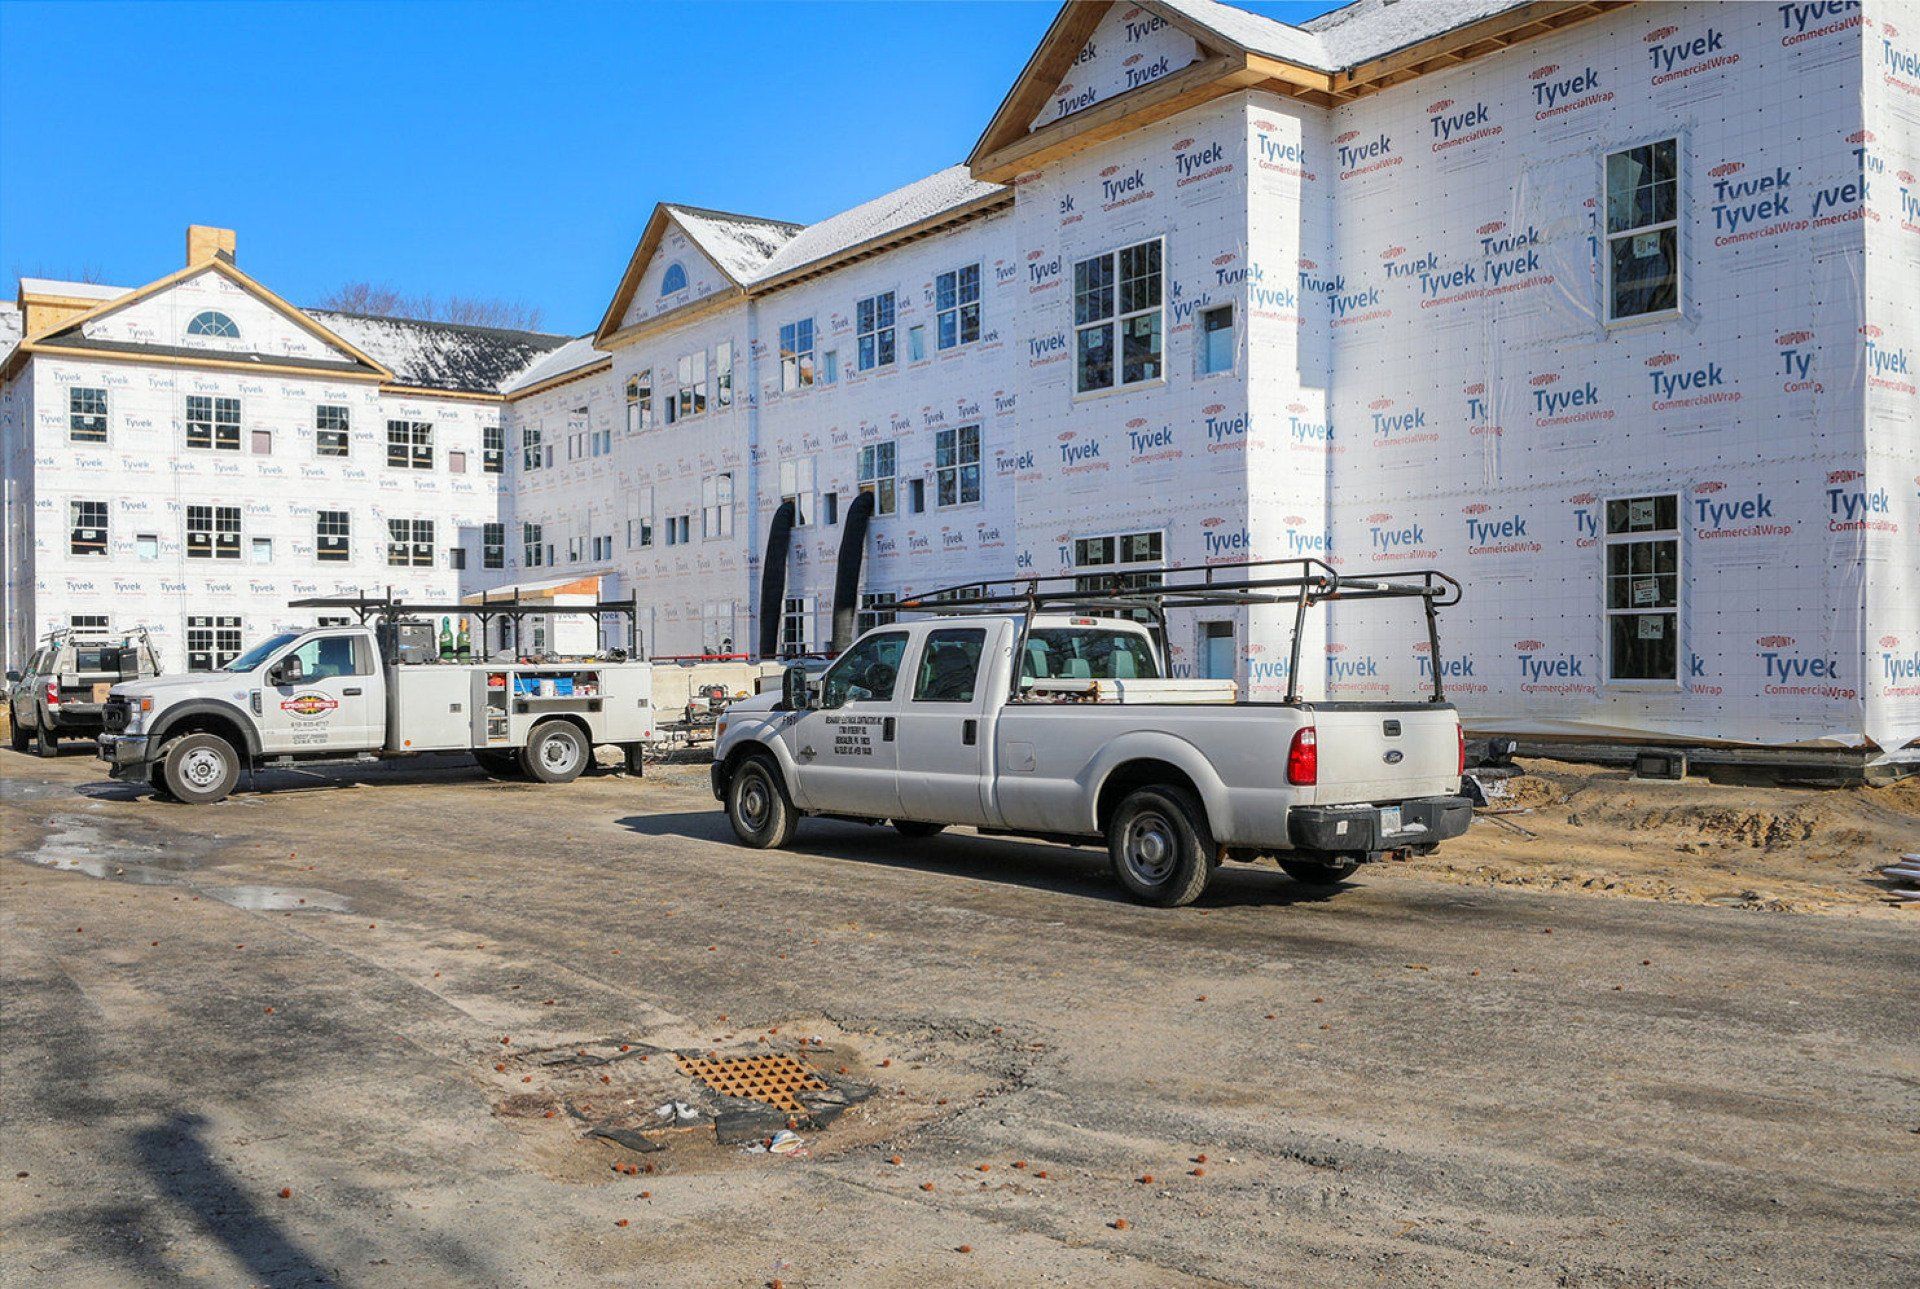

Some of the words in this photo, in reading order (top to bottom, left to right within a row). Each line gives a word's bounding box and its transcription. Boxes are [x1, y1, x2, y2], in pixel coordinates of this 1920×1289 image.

[1648, 28, 1723, 72] Tyvek
[1125, 56, 1168, 87] Tyvek
[1650, 53, 1740, 86] CommercialWrap
[1533, 67, 1599, 108] Tyvek
[1057, 86, 1097, 116] Tyvek
[1535, 90, 1615, 122] CommercialWrap
[1431, 102, 1488, 140] Tyvek
[1257, 134, 1306, 164] Tyvek
[1338, 134, 1391, 168] Tyvek
[1432, 124, 1503, 153] CommercialWrap
[1175, 142, 1223, 176] Tyvek
[1340, 156, 1403, 181] CommercialWrap
[1102, 169, 1145, 201] Tyvek
[1711, 192, 1789, 233] Tyvek
[1714, 219, 1809, 247] CommercialWrap
[1419, 265, 1475, 299] Tyvek
[1246, 282, 1295, 309] Tyvek
[1327, 286, 1379, 317] Tyvek
[1028, 332, 1066, 360] Tyvek
[1866, 341, 1907, 375] Tyvek
[54, 371, 80, 383] Tyvek
[1781, 350, 1811, 379] Ty
[102, 374, 128, 386] Tyvek
[148, 377, 174, 389] Tyvek
[194, 381, 219, 392] Tyvek
[238, 384, 263, 394] Tyvek
[281, 387, 305, 398] Tyvek
[1650, 362, 1723, 399] Tyvek
[324, 390, 347, 401] Tyvek
[1533, 382, 1598, 416] Tyvek
[1651, 390, 1741, 412] CommercialWrap
[125, 417, 152, 429] Tyvek
[1205, 412, 1253, 441] Tyvek
[1288, 416, 1335, 441] Tyvek
[1372, 407, 1425, 437] Tyvek
[1536, 409, 1615, 427] CommercialWrap
[1060, 439, 1100, 465] Tyvek
[1129, 426, 1173, 453] Tyvek
[75, 458, 102, 469] Tyvek
[122, 460, 149, 471] Tyvek
[169, 462, 194, 472] Tyvek
[214, 463, 240, 474] Tyvek
[257, 465, 283, 476] Tyvek
[301, 468, 324, 478] Tyvek
[342, 469, 365, 479] Tyvek
[121, 501, 147, 512] Tyvek
[1695, 494, 1773, 529] Tyvek
[1826, 487, 1889, 520] Tyvek
[978, 525, 1000, 542] Tyvek
[1203, 527, 1251, 556] Tyvek
[1286, 528, 1332, 553] Tyvek
[1370, 524, 1424, 552] Tyvek
[1466, 515, 1526, 544] Tyvek
[1698, 525, 1792, 540] CommercialWrap
[66, 581, 93, 592] Tyvek
[114, 581, 141, 593] Tyvek
[160, 582, 187, 593] Tyvek
[206, 582, 231, 593] Tyvek
[250, 583, 275, 594] Tyvek
[293, 584, 317, 594] Tyvek
[1326, 655, 1377, 681] Tyvek
[1519, 654, 1582, 682] Tyvek
